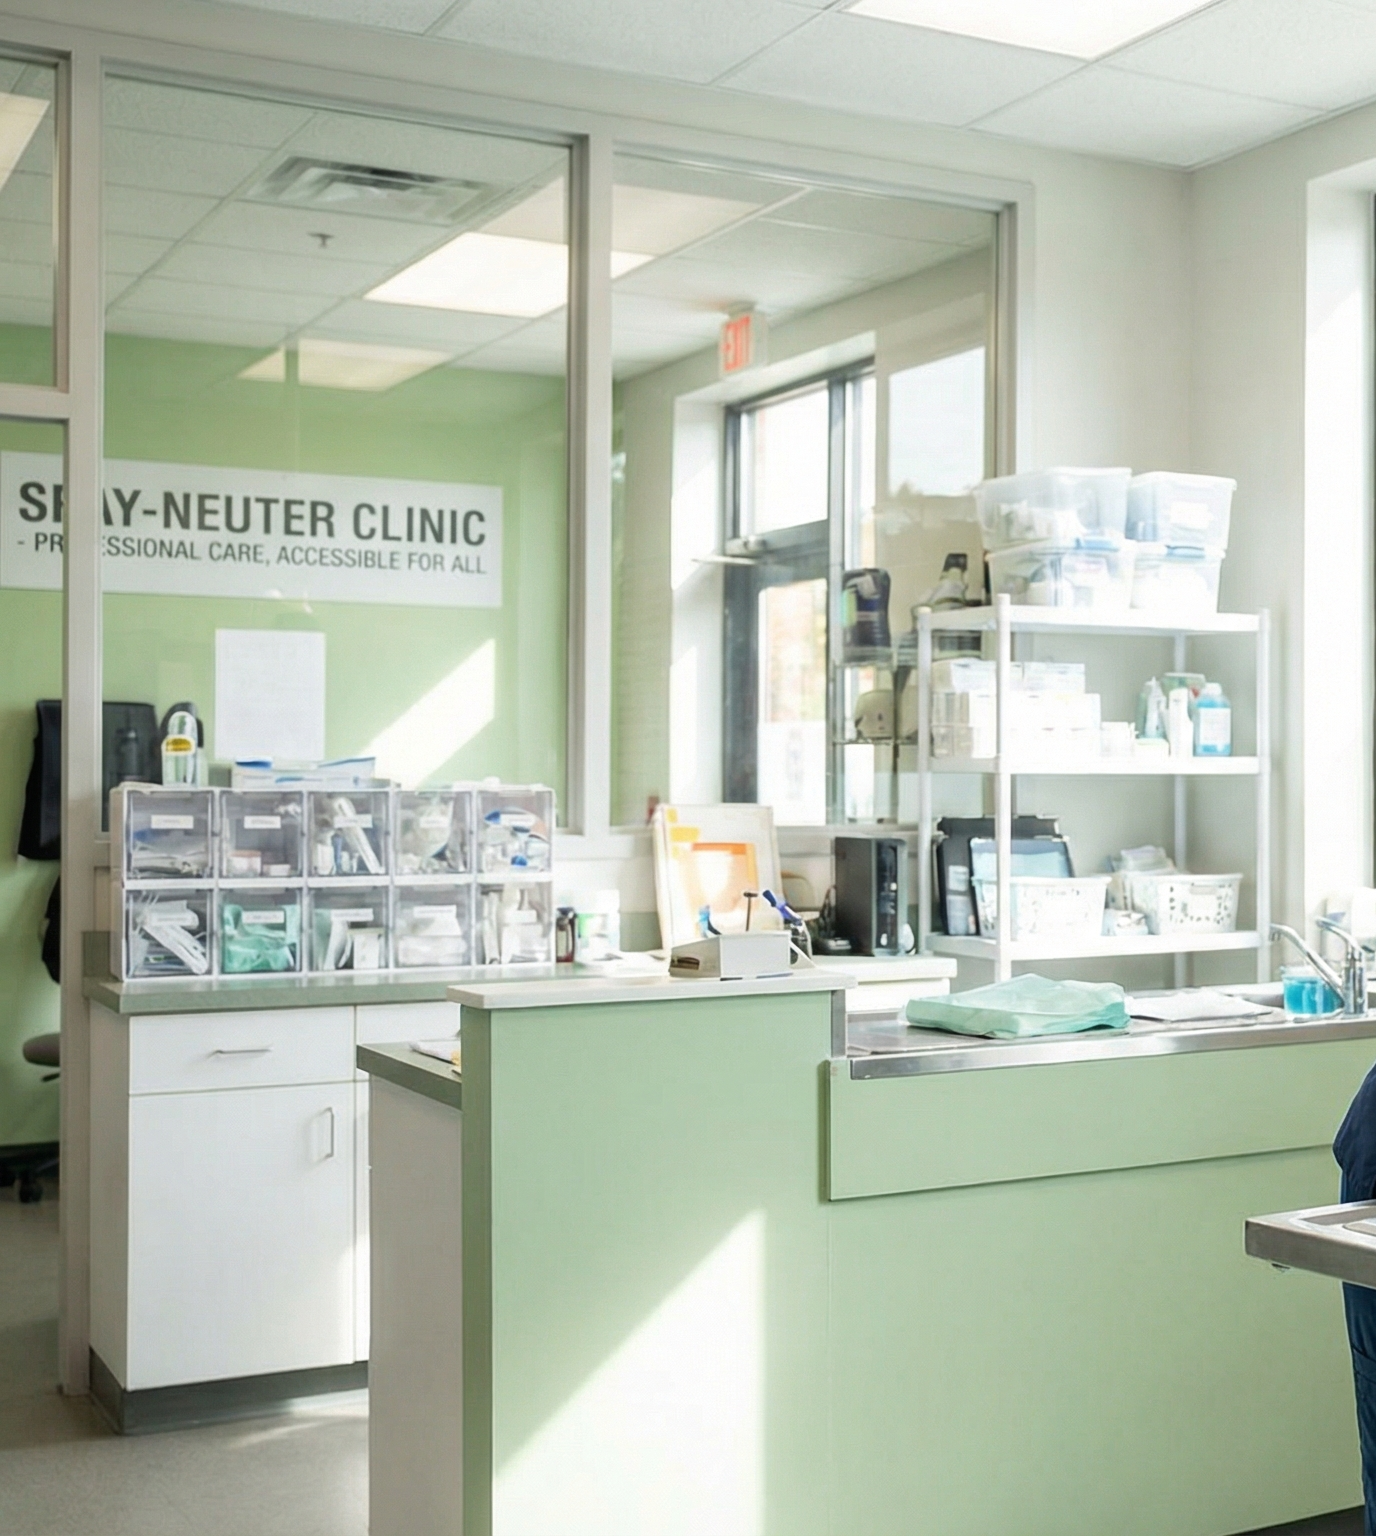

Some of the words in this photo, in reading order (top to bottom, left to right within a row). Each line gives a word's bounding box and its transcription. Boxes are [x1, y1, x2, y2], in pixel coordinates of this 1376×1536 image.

[352, 502, 487, 546] CLINIC
[34, 531, 202, 560] PRSSIONAL
[208, 541, 271, 566] CARE,
[276, 545, 401, 571] ACCESSIBLE
[407, 552, 446, 572] FOR
[451, 555, 488, 574] ALL
